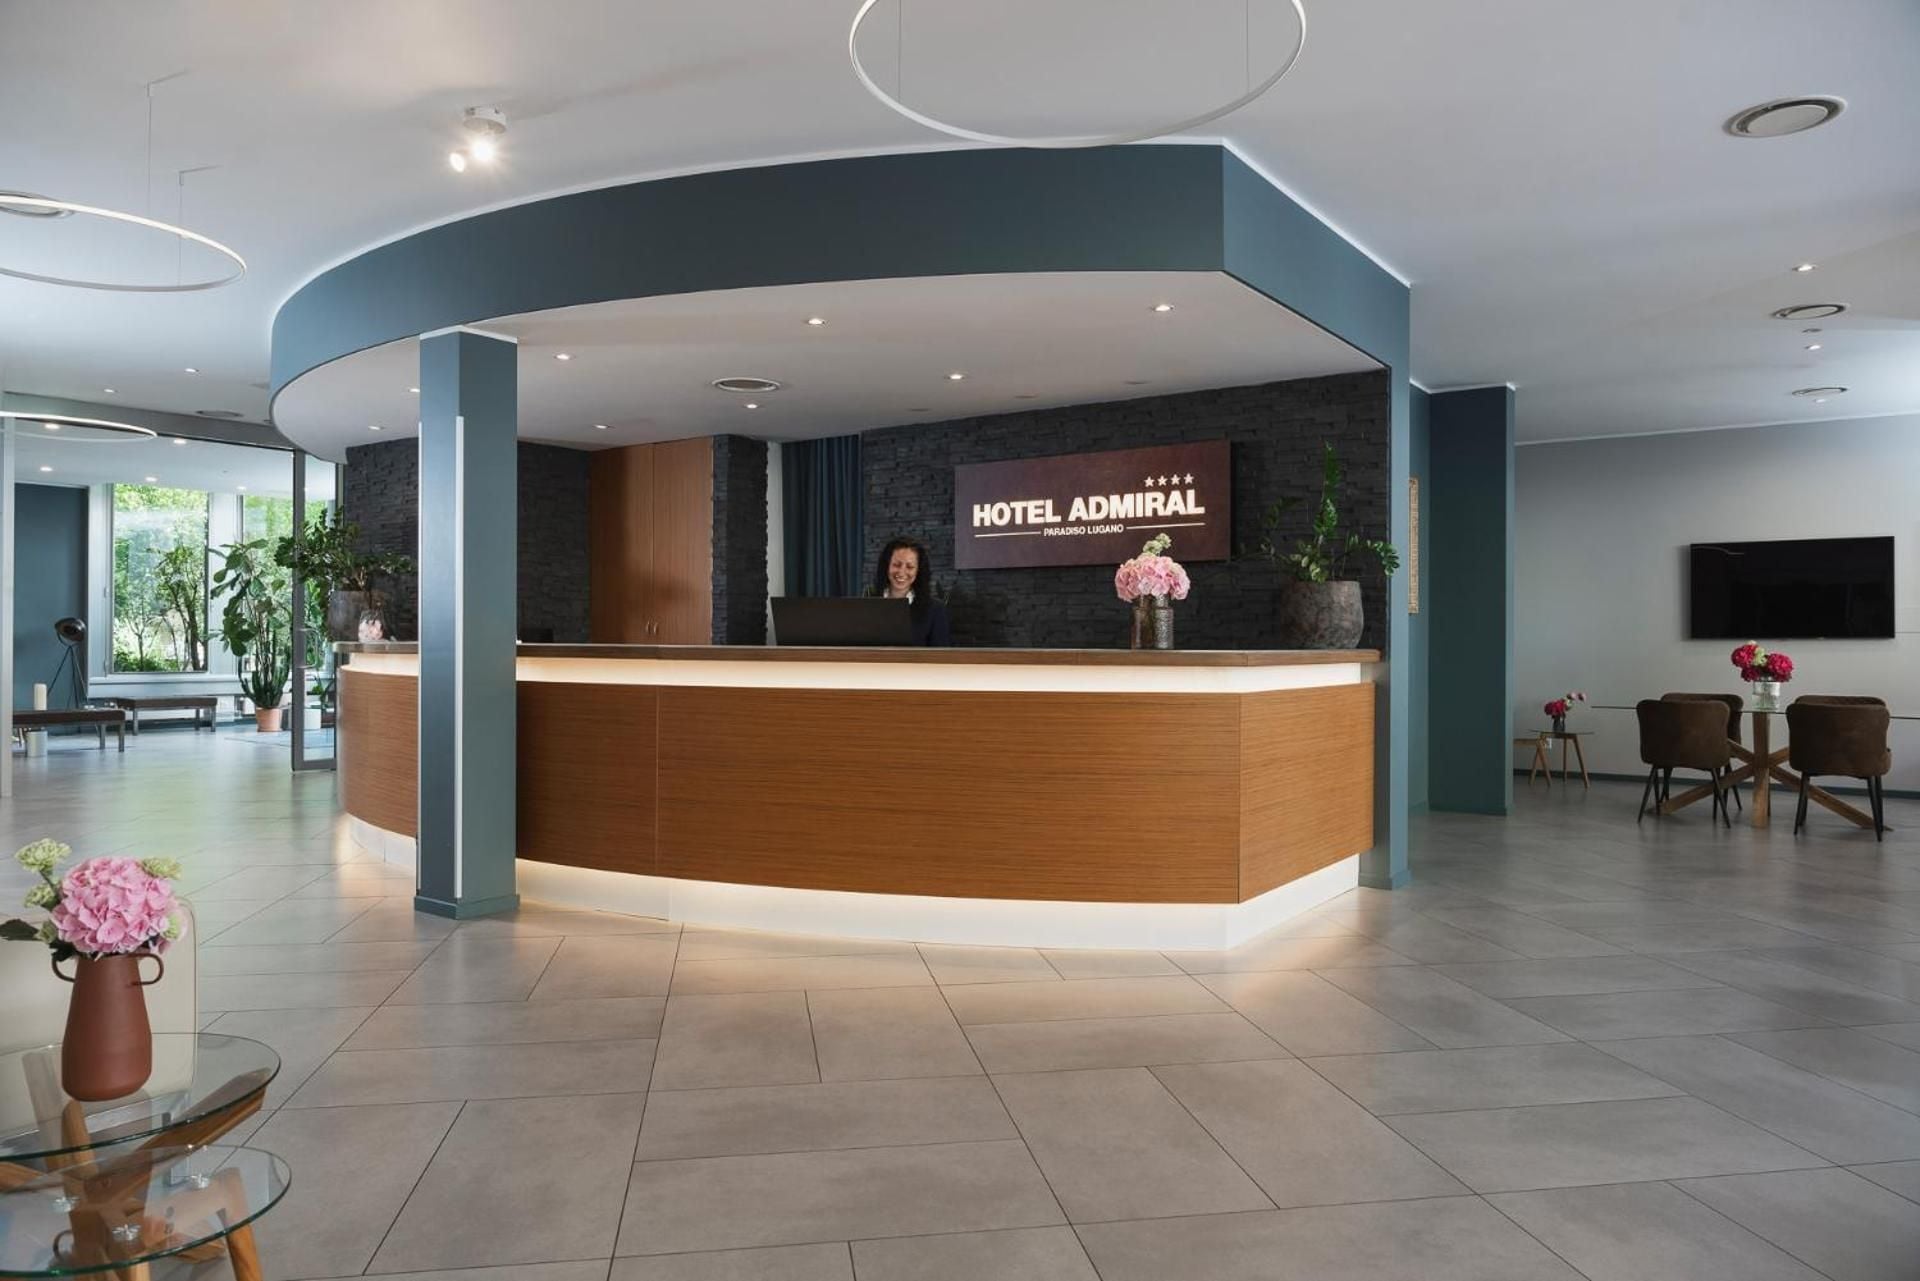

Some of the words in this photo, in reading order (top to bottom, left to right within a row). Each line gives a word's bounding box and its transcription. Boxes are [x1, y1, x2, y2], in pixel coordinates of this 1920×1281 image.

[973, 499, 1061, 527] HOTEL
[1067, 489, 1205, 522] ADMIRAL
[1043, 526, 1086, 536] PARADISO
[1087, 524, 1124, 535] LUGANO
